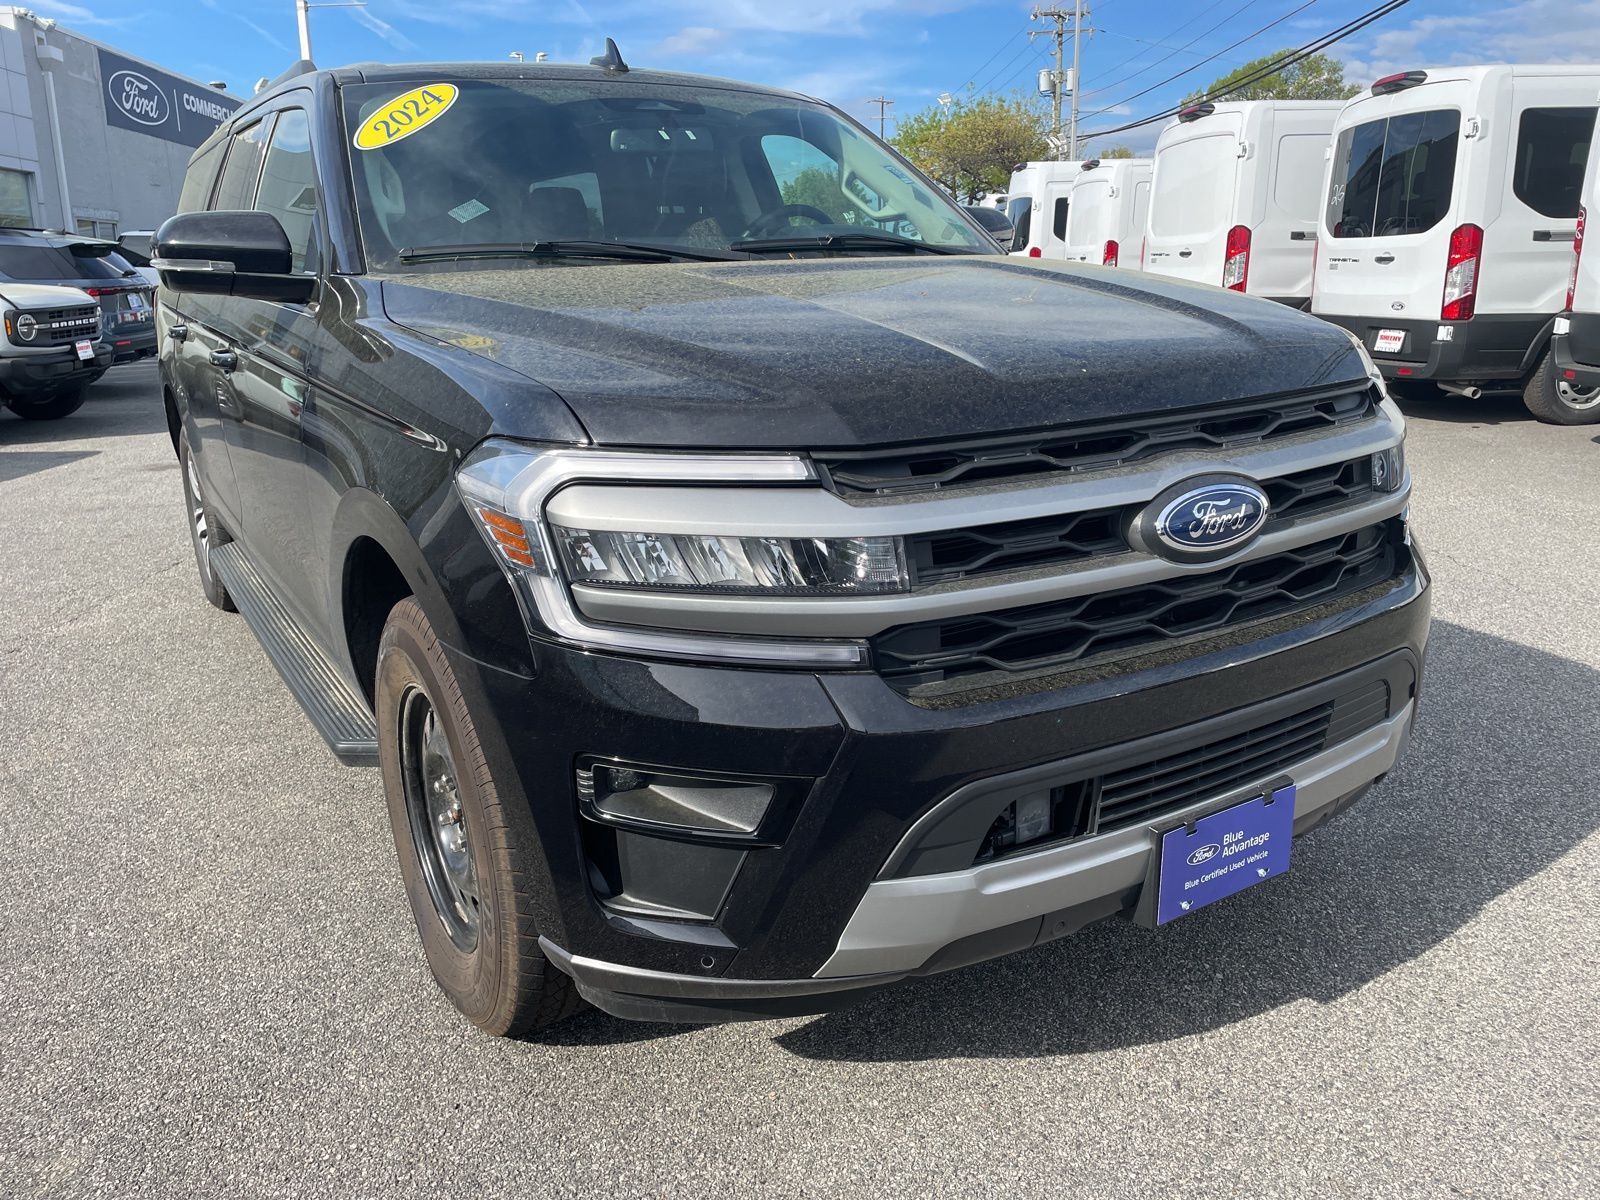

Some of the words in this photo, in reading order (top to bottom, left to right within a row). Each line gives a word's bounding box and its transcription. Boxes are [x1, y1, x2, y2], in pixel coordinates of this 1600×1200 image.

[122, 76, 159, 119] Ford
[373, 89, 446, 139] 2024
[51, 317, 96, 328] BRONCO
[1188, 497, 1247, 539] Ford
[1222, 832, 1270, 859] Advantage
[1223, 830, 1244, 846] Blue
[1184, 879, 1200, 890] Blue
[1200, 865, 1228, 883] Certified
[1229, 858, 1246, 872] Used
[1246, 850, 1269, 864] Vehicle
